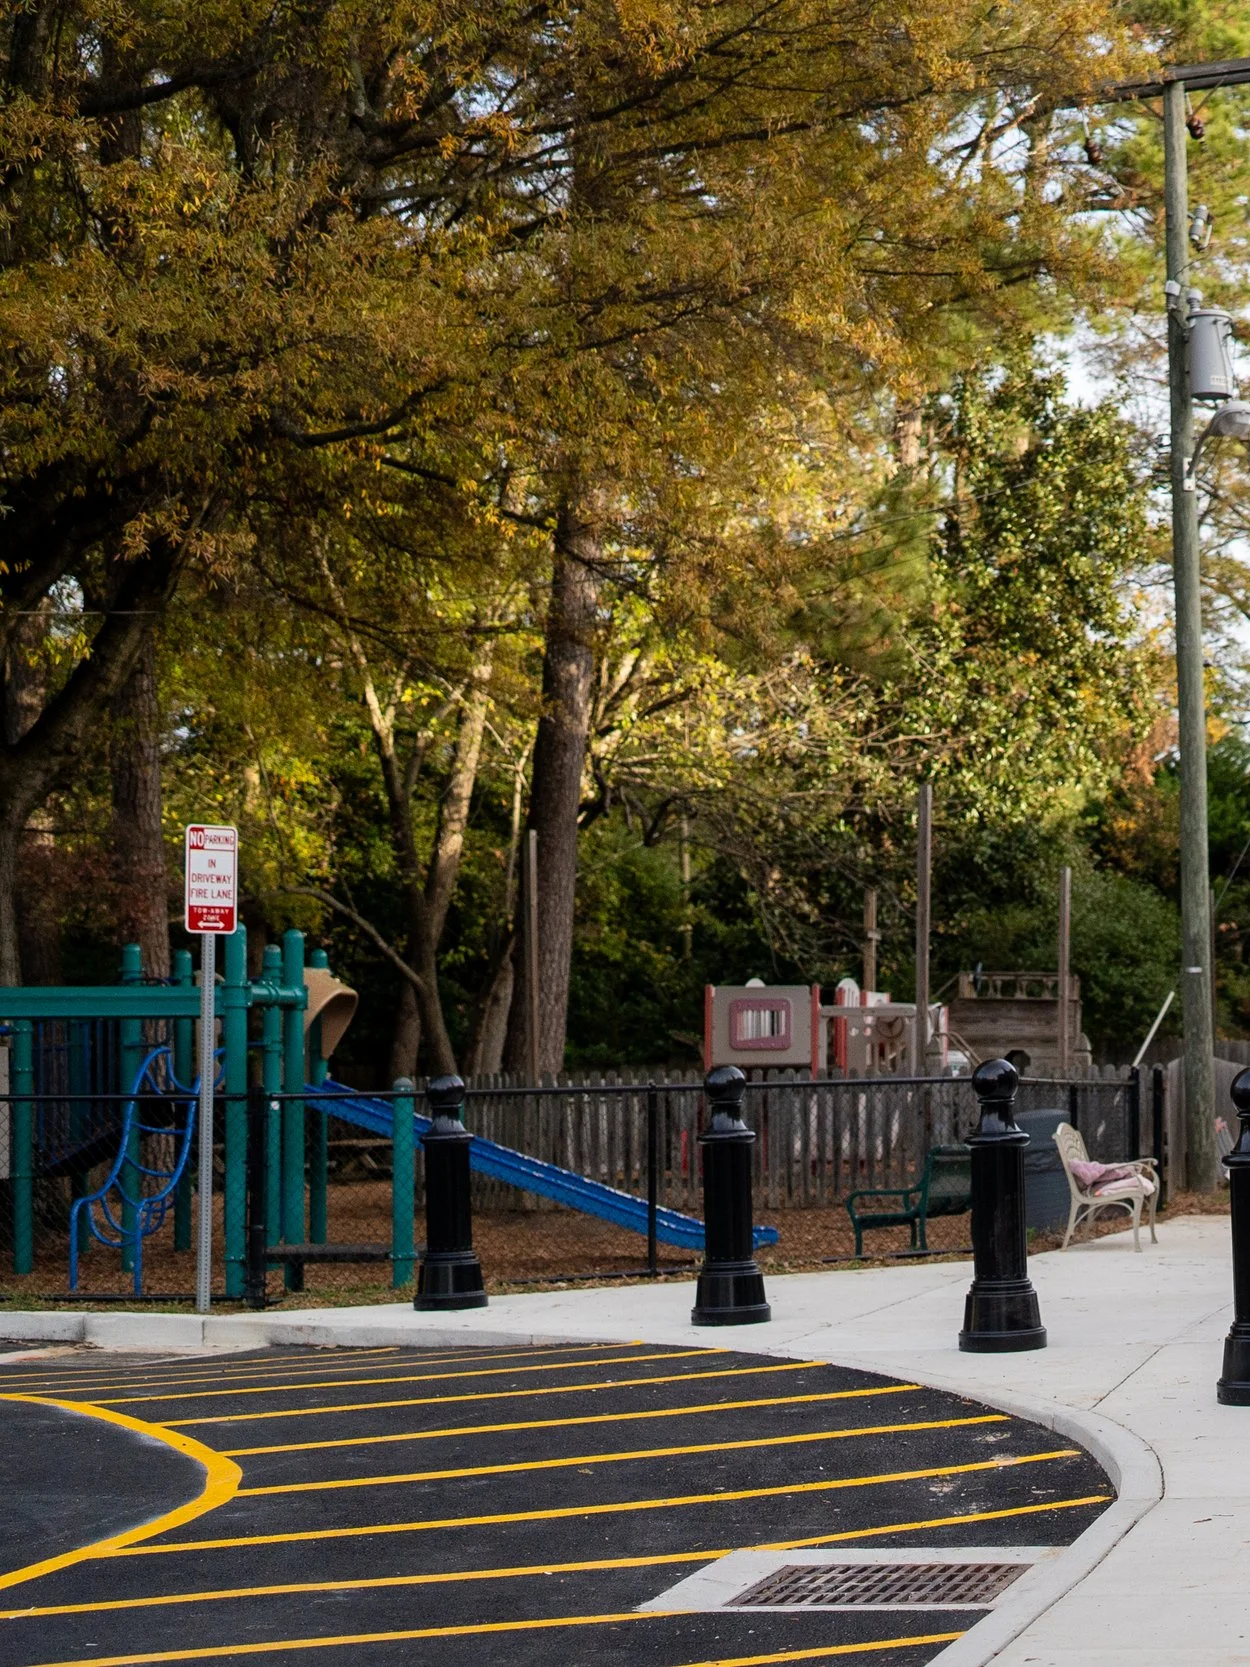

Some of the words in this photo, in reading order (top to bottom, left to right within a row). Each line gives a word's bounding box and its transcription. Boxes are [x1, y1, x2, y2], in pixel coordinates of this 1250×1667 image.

[190, 830, 204, 847] NO
[204, 834, 235, 846] PARKING
[208, 859, 216, 869] IN
[191, 873, 232, 885] DRIVEWAY
[190, 888, 208, 899] FIRE
[211, 889, 233, 900] LANE
[193, 907, 230, 915] TOW-AWAY
[203, 914, 220, 922] ZONE
